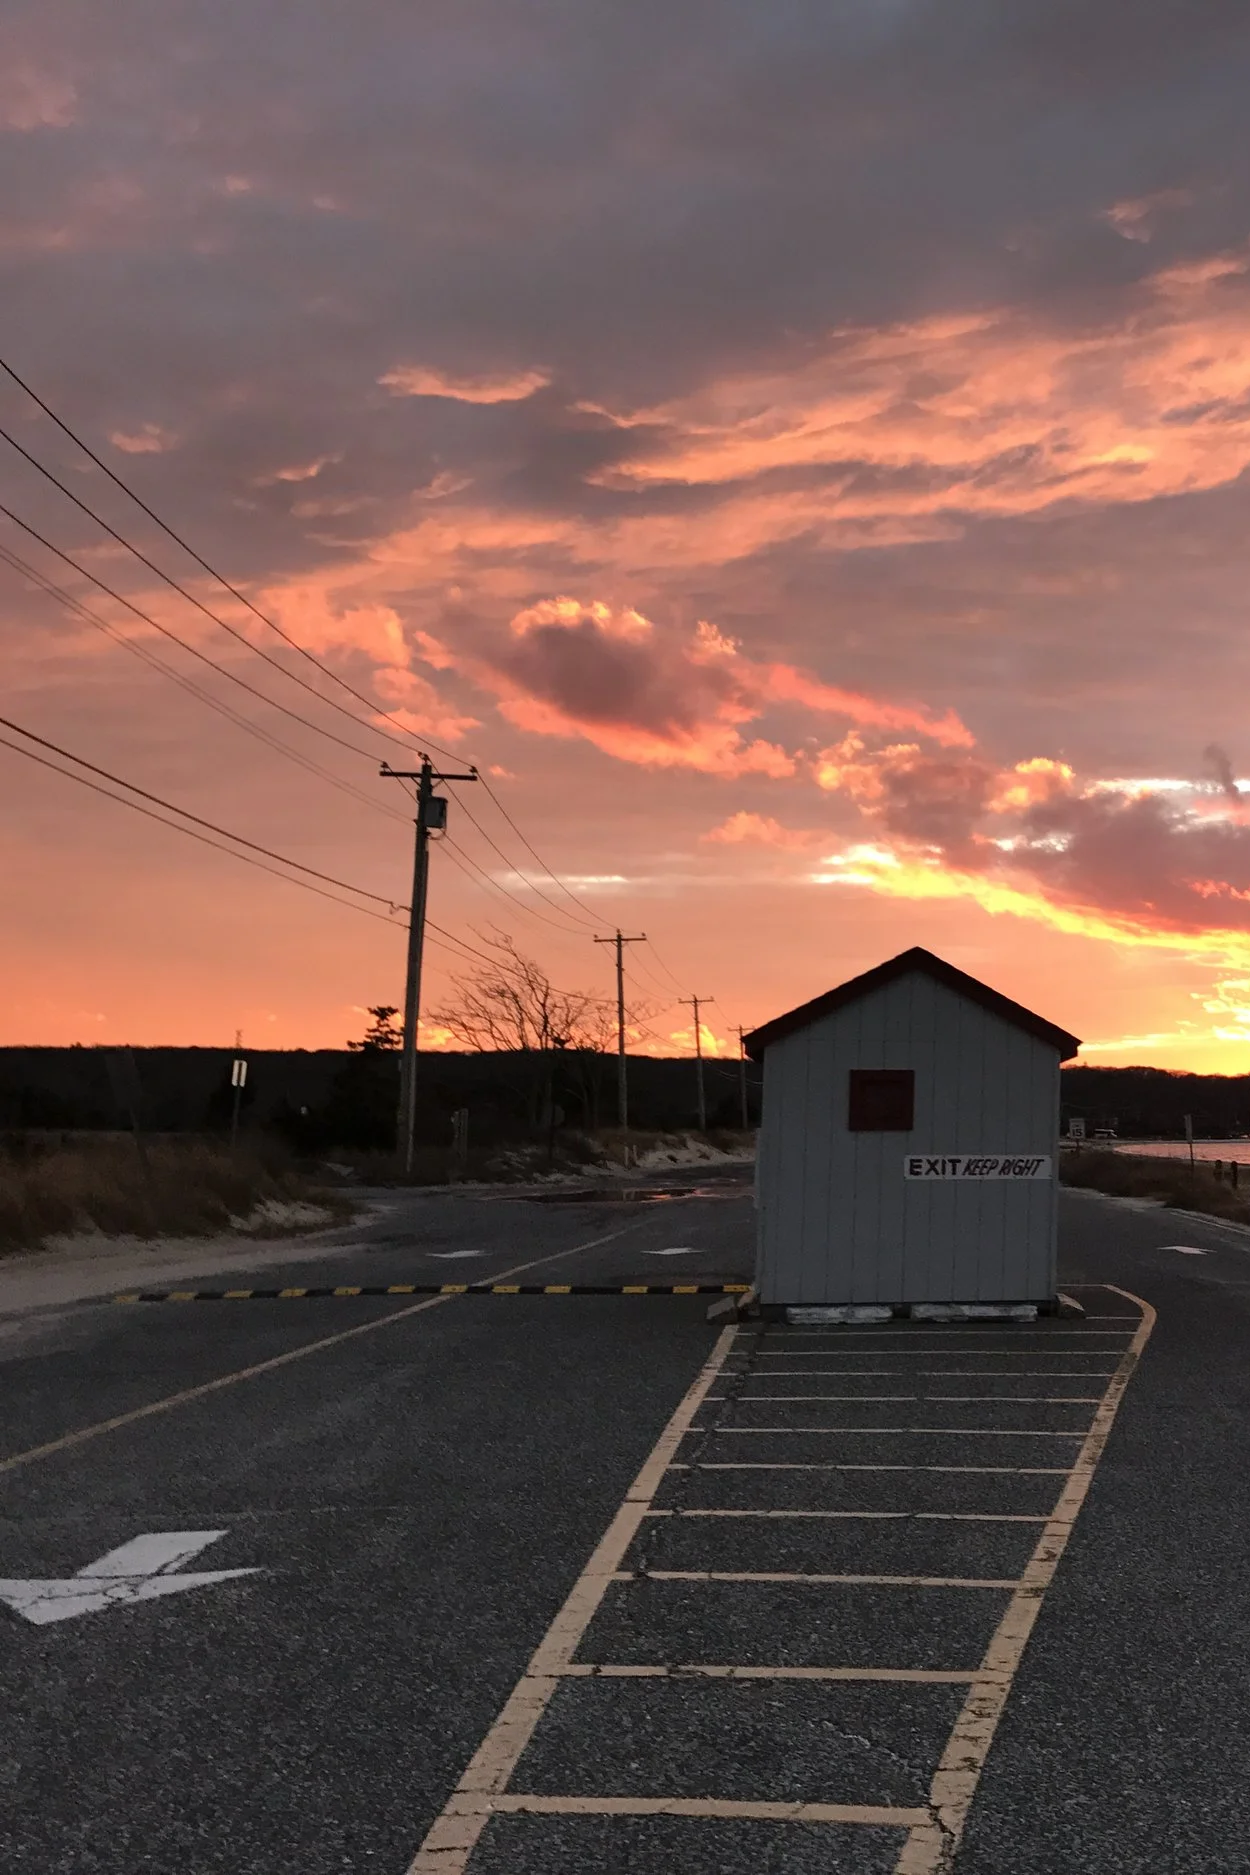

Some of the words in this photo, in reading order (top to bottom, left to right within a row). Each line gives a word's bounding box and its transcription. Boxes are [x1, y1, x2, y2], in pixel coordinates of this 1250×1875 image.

[1072, 1128, 1082, 1137] 15
[909, 1158, 962, 1176] EXIT
[961, 1158, 999, 1176] KEEP
[999, 1158, 1044, 1176] RIGHT
